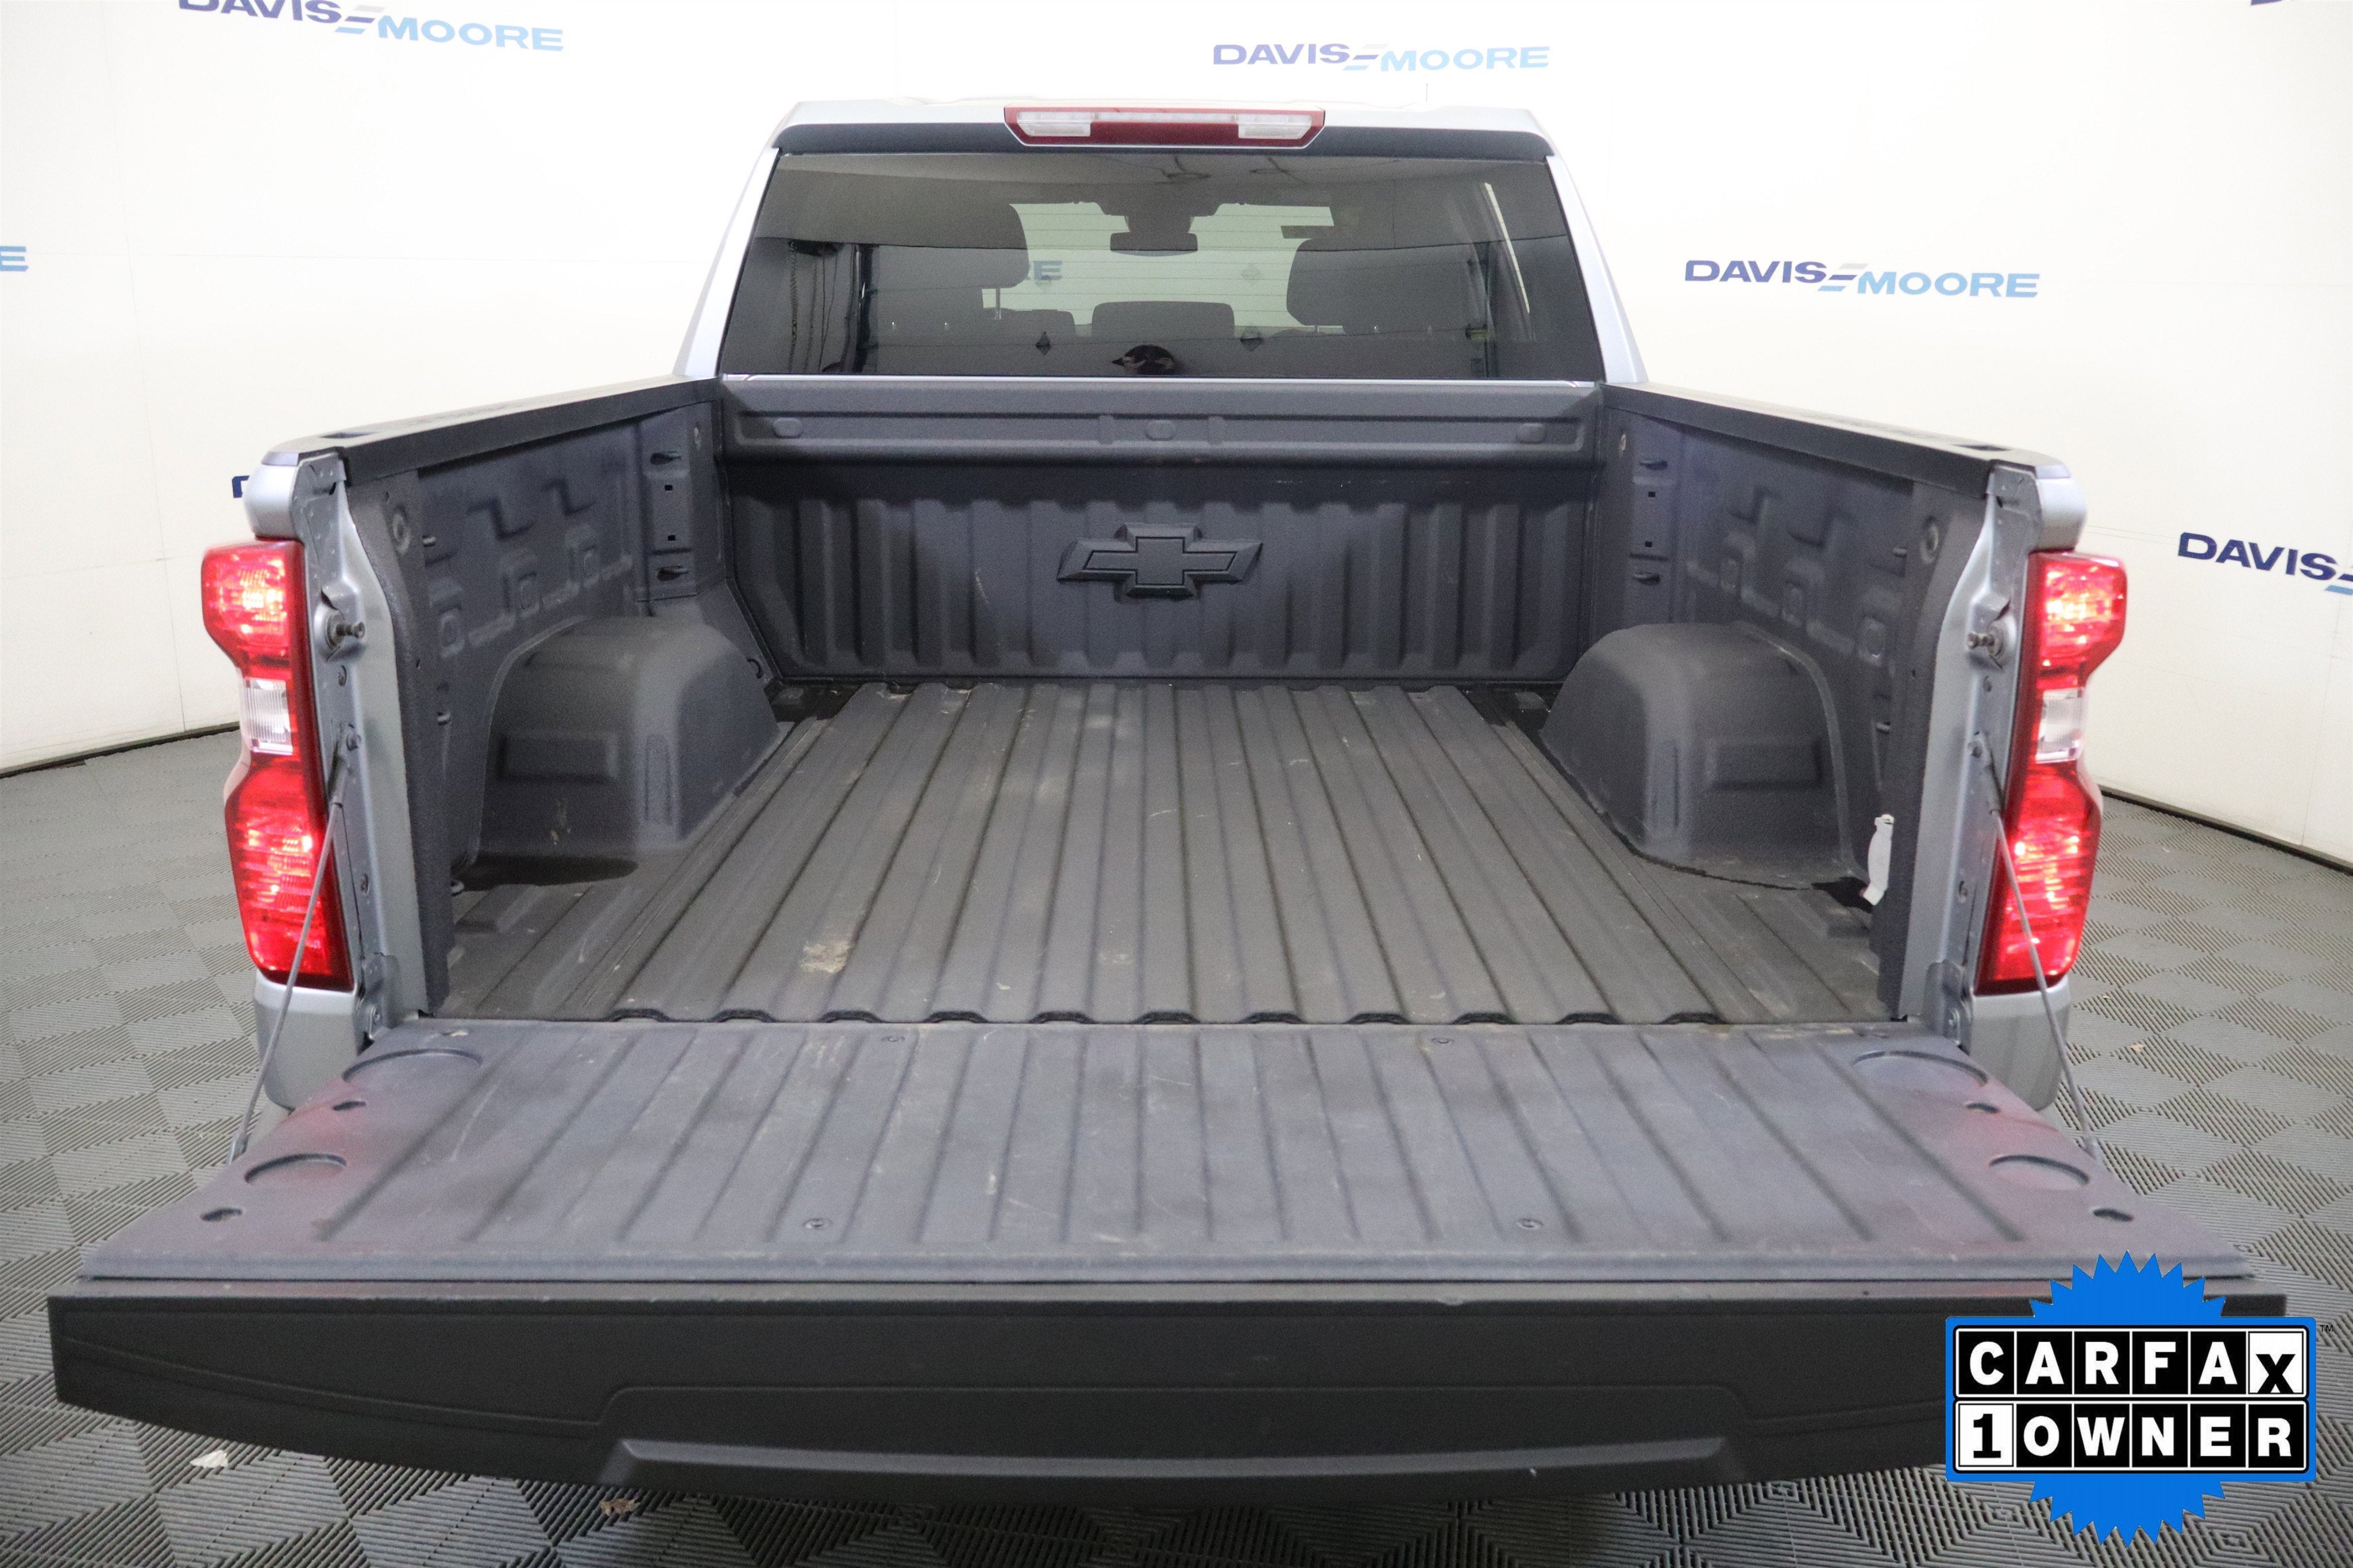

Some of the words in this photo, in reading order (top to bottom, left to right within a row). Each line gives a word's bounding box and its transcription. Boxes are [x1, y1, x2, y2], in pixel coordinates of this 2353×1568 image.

[377, 15, 564, 52] MOORE
[1213, 43, 1351, 65] DAVIS
[1380, 46, 1550, 72] MOORE
[1684, 260, 1827, 283] DAVIS
[1857, 271, 2040, 298] MOORE
[2177, 532, 2339, 581] DAVIS
